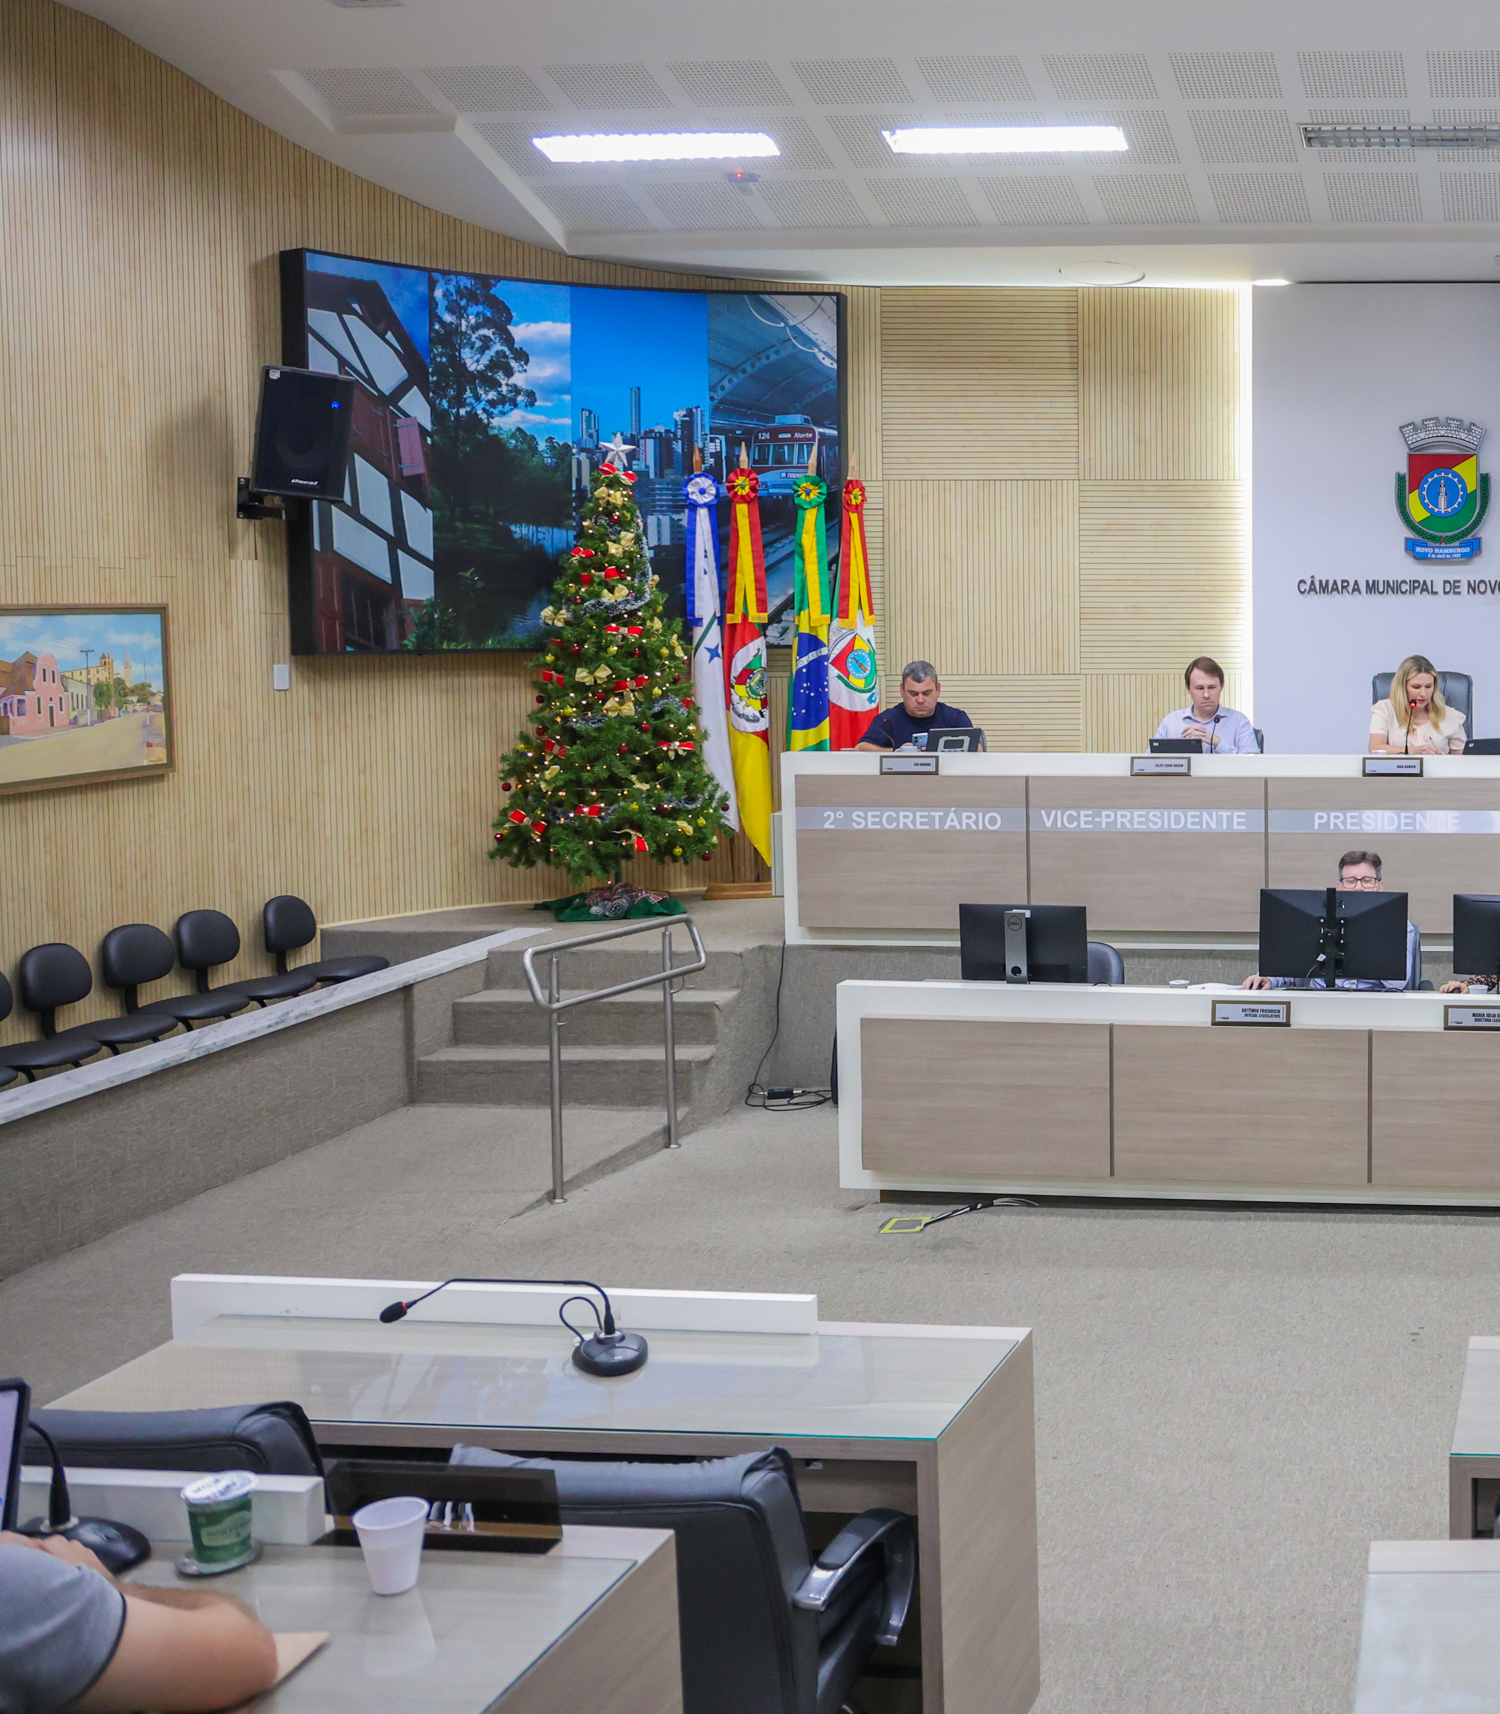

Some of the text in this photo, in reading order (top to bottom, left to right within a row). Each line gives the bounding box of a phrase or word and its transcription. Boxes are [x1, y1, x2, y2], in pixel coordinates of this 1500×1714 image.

[1297, 575, 1362, 595] CÂMARA
[1365, 579, 1438, 595] MUNICIPAL
[1443, 579, 1461, 595] DE
[851, 807, 1001, 830] SECRETÁRIO
[1040, 810, 1246, 830] VICE-PRESIDENTE
[1314, 811, 1460, 830] PRESIDENTE
